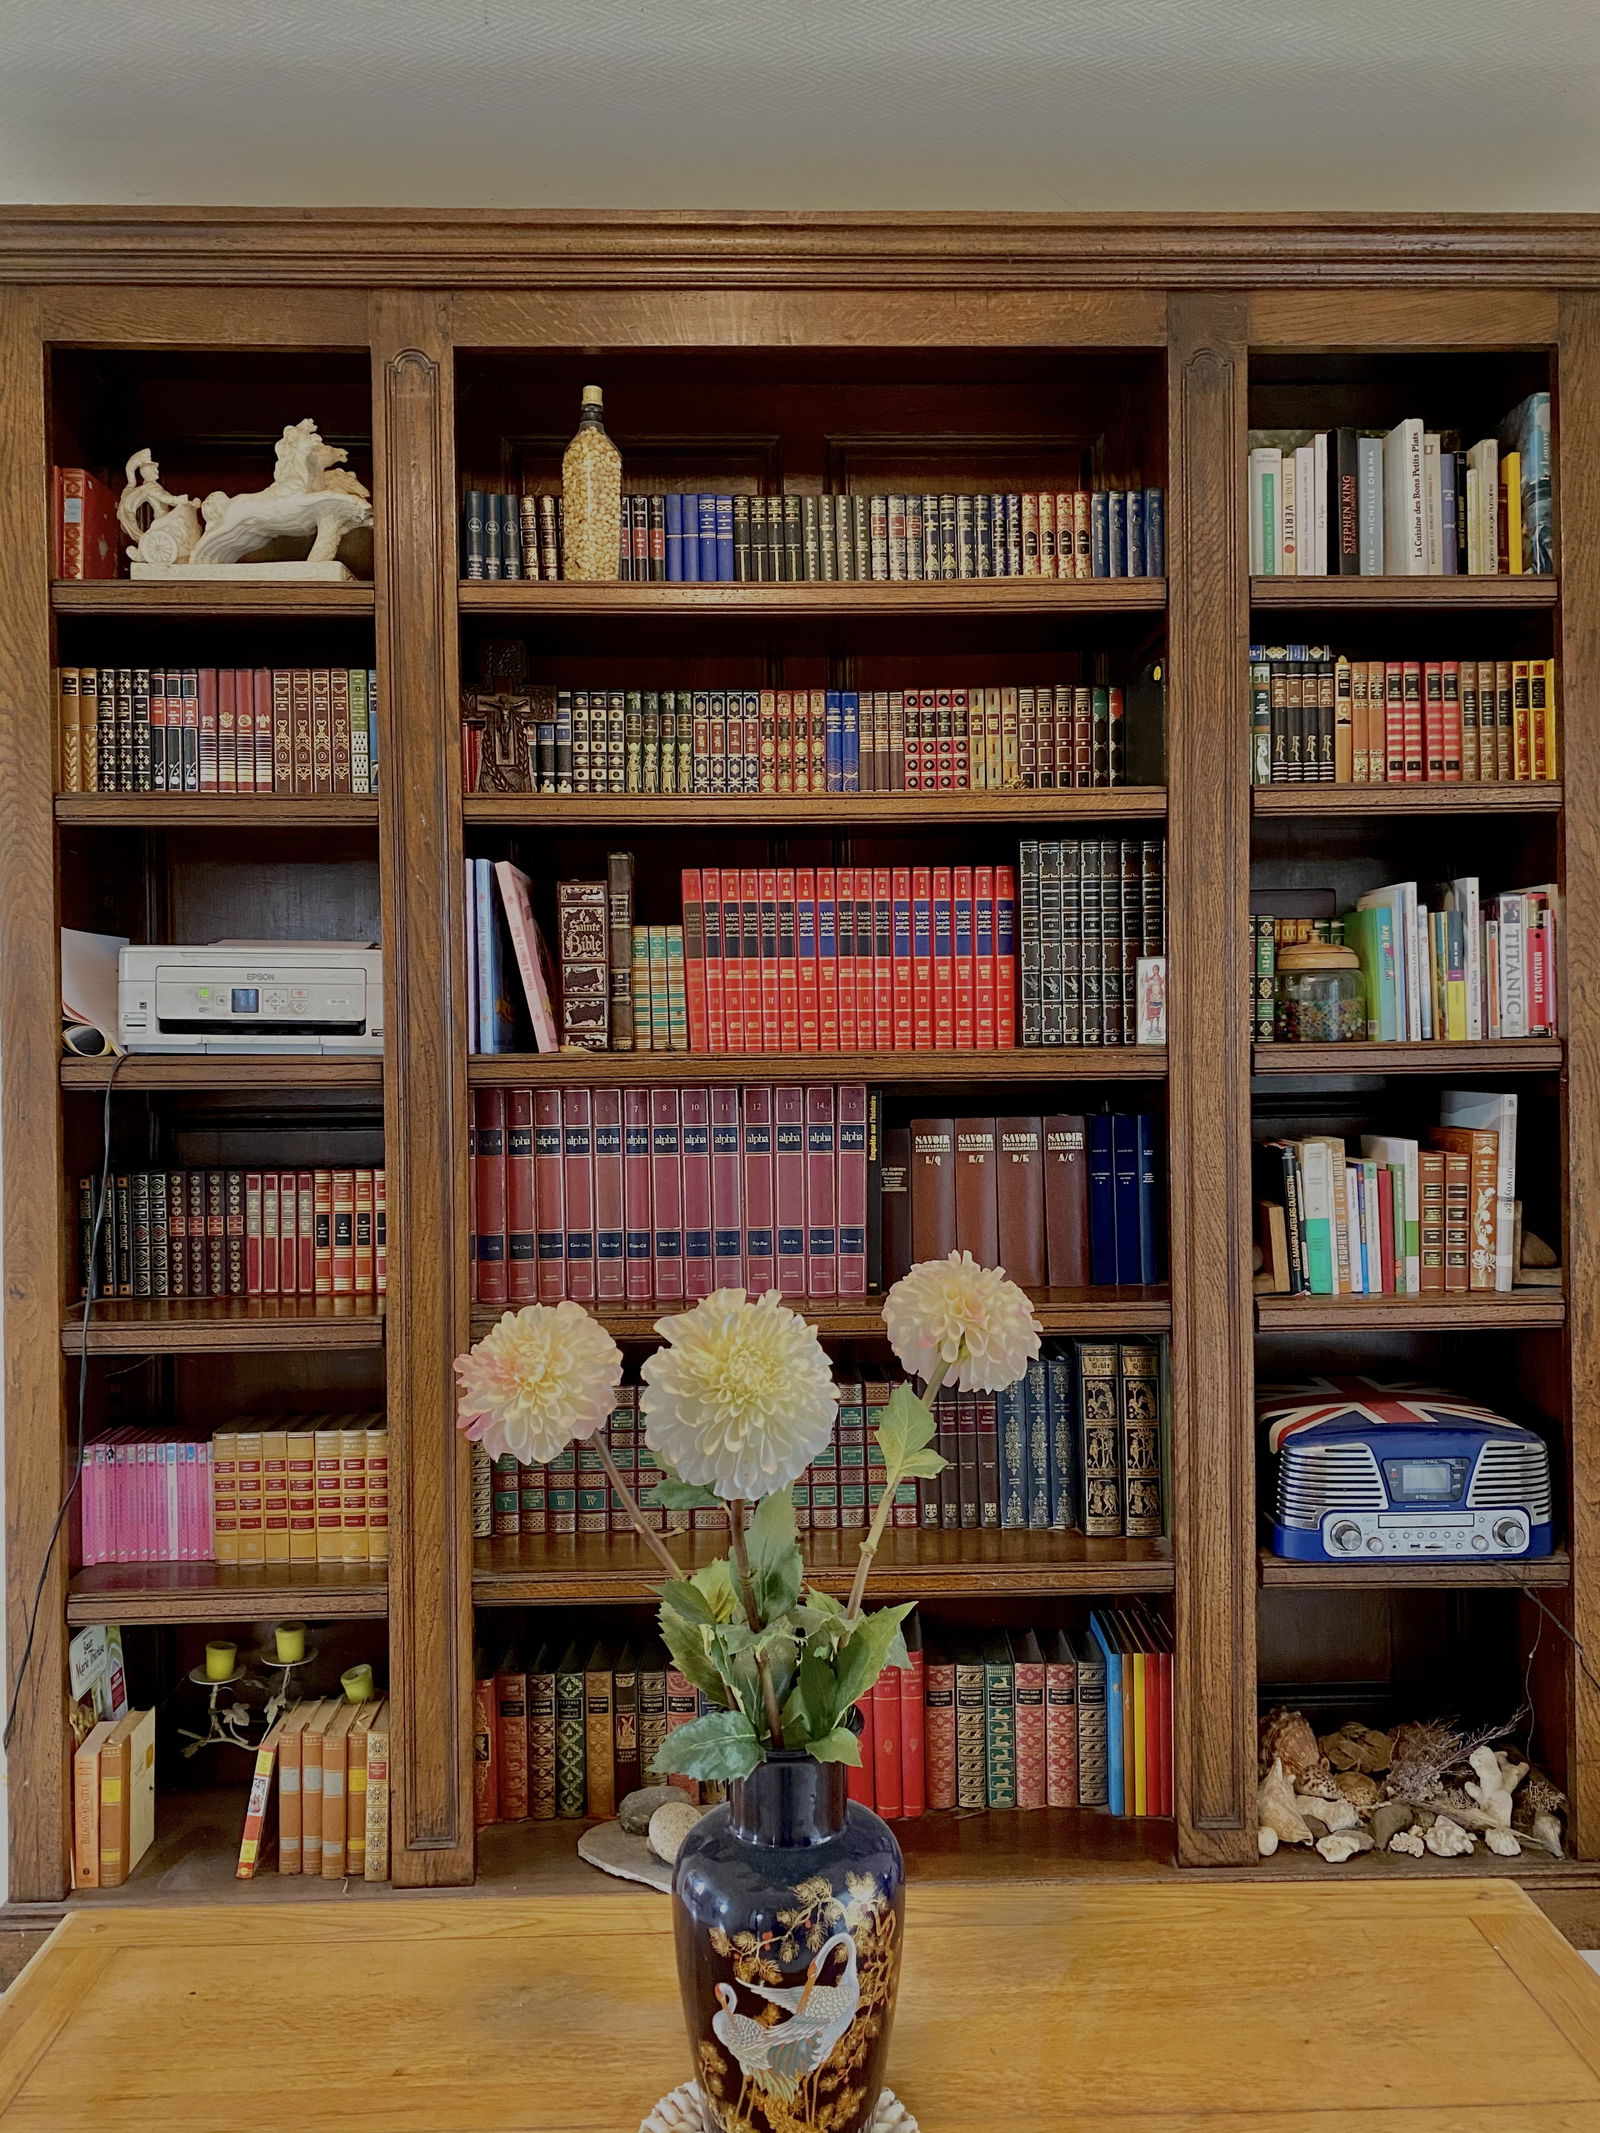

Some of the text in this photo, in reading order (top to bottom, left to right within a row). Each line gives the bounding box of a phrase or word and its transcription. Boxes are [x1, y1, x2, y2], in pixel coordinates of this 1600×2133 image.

[1367, 450, 1375, 485] OBAMA
[1411, 432, 1423, 558] La Cuisine des Bons Petits Plats
[1342, 475, 1353, 555] STEPHEN KING
[1368, 488, 1376, 535] MICHELLE
[1284, 504, 1296, 542] VÉRITÉ
[570, 921, 601, 932] Sainte
[1381, 925, 1390, 940] lire
[567, 932, 602, 954] Bible
[246, 973, 275, 981] EPSON
[1505, 929, 1522, 1014] TITANIC
[1533, 951, 1544, 1004] LE DICTATEUR
[517, 1105, 522, 1113] 3
[544, 1104, 550, 1112] 4
[574, 1104, 579, 1112] 5
[633, 1105, 639, 1113] 7
[691, 1103, 699, 1111] 10
[721, 1103, 729, 1111] 11
[753, 1103, 761, 1111] 12
[785, 1102, 793, 1110] 13
[869, 1095, 877, 1161] Enquête sur l'histoire
[537, 1132, 559, 1147] alpha
[566, 1132, 589, 1146] alpha
[597, 1131, 619, 1145] alpha
[627, 1132, 648, 1145] alpha
[654, 1131, 677, 1146] alpha
[685, 1132, 706, 1146] alpha
[714, 1131, 737, 1145] alpha
[747, 1131, 769, 1144] alpha
[778, 1130, 801, 1144] alpha
[810, 1130, 832, 1143] alpha
[842, 1130, 863, 1142] alpha
[915, 1135, 950, 1144] SAVOIR
[958, 1134, 993, 1143] SAVOIR
[1002, 1133, 1038, 1142] SAVOIR
[1047, 1132, 1083, 1141] SAVOIR
[925, 1155, 942, 1165] L/Q
[968, 1154, 985, 1163] R/Z
[1012, 1153, 1030, 1162] D/K
[1058, 1153, 1075, 1161] A/C
[1504, 1167, 1514, 1214] un voyage
[1335, 1192, 1346, 1203] LA
[116, 1190, 128, 1224] premier
[1336, 1206, 1346, 1215] DE
[1286, 1175, 1301, 1271] LES MANIPULATEURS DU DESTIN
[1339, 1268, 1349, 1282] LES
